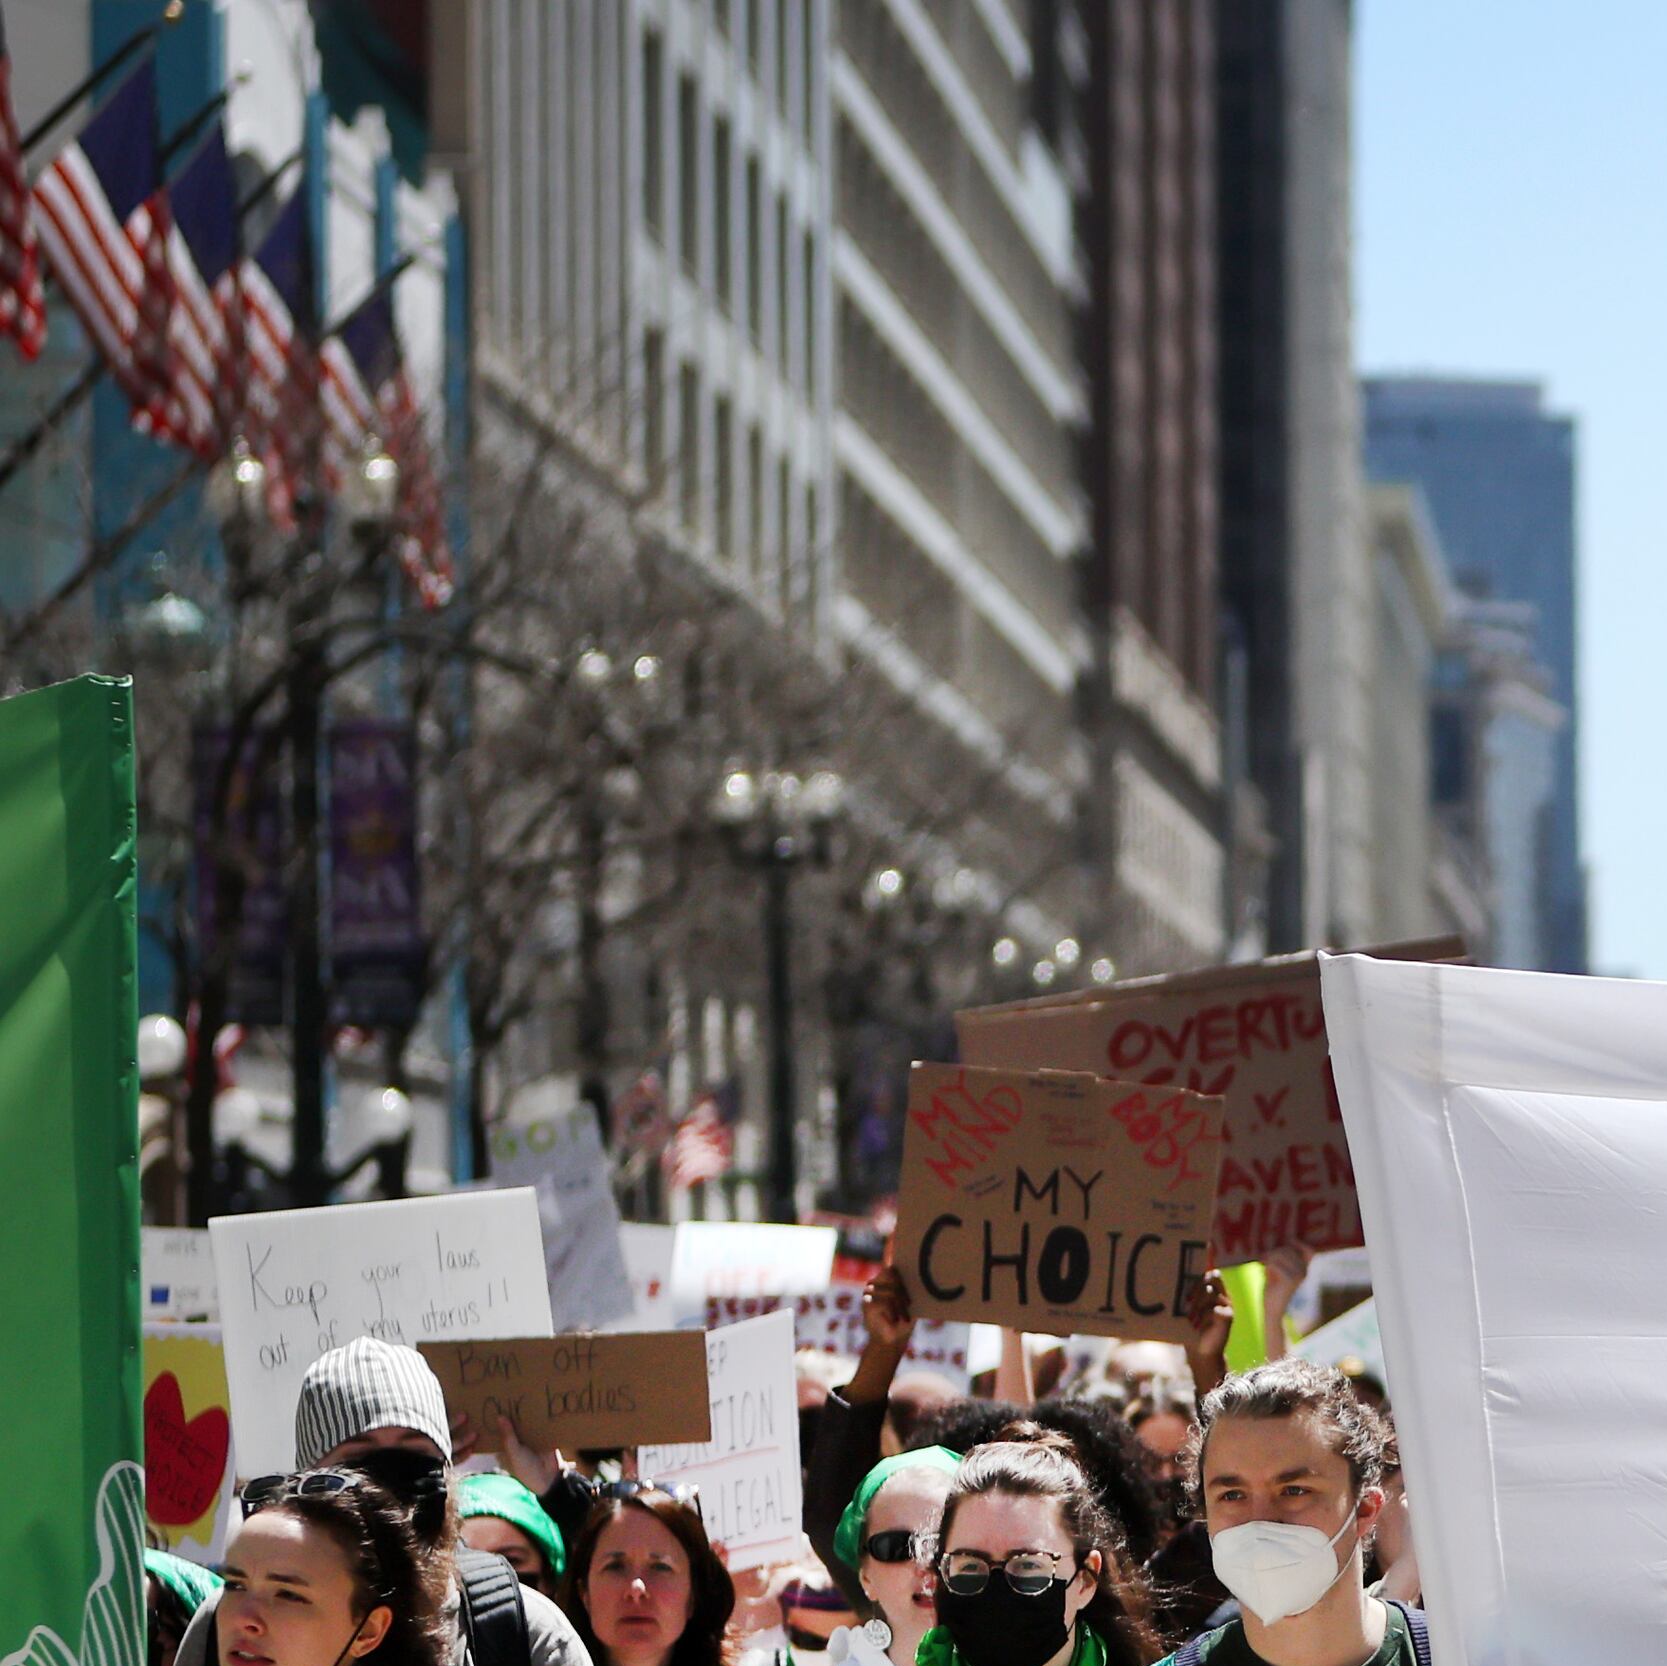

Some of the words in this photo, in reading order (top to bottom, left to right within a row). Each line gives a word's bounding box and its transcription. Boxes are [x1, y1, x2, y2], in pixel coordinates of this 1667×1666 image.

[1013, 1166, 1103, 1220] MY
[246, 1241, 328, 1325] Keep
[361, 1262, 403, 1318] your
[435, 1230, 481, 1273] laws
[918, 1213, 1208, 1318] CHOICE
[546, 1385, 638, 1419] bodies
[719, 1466, 794, 1542] LEGAL
